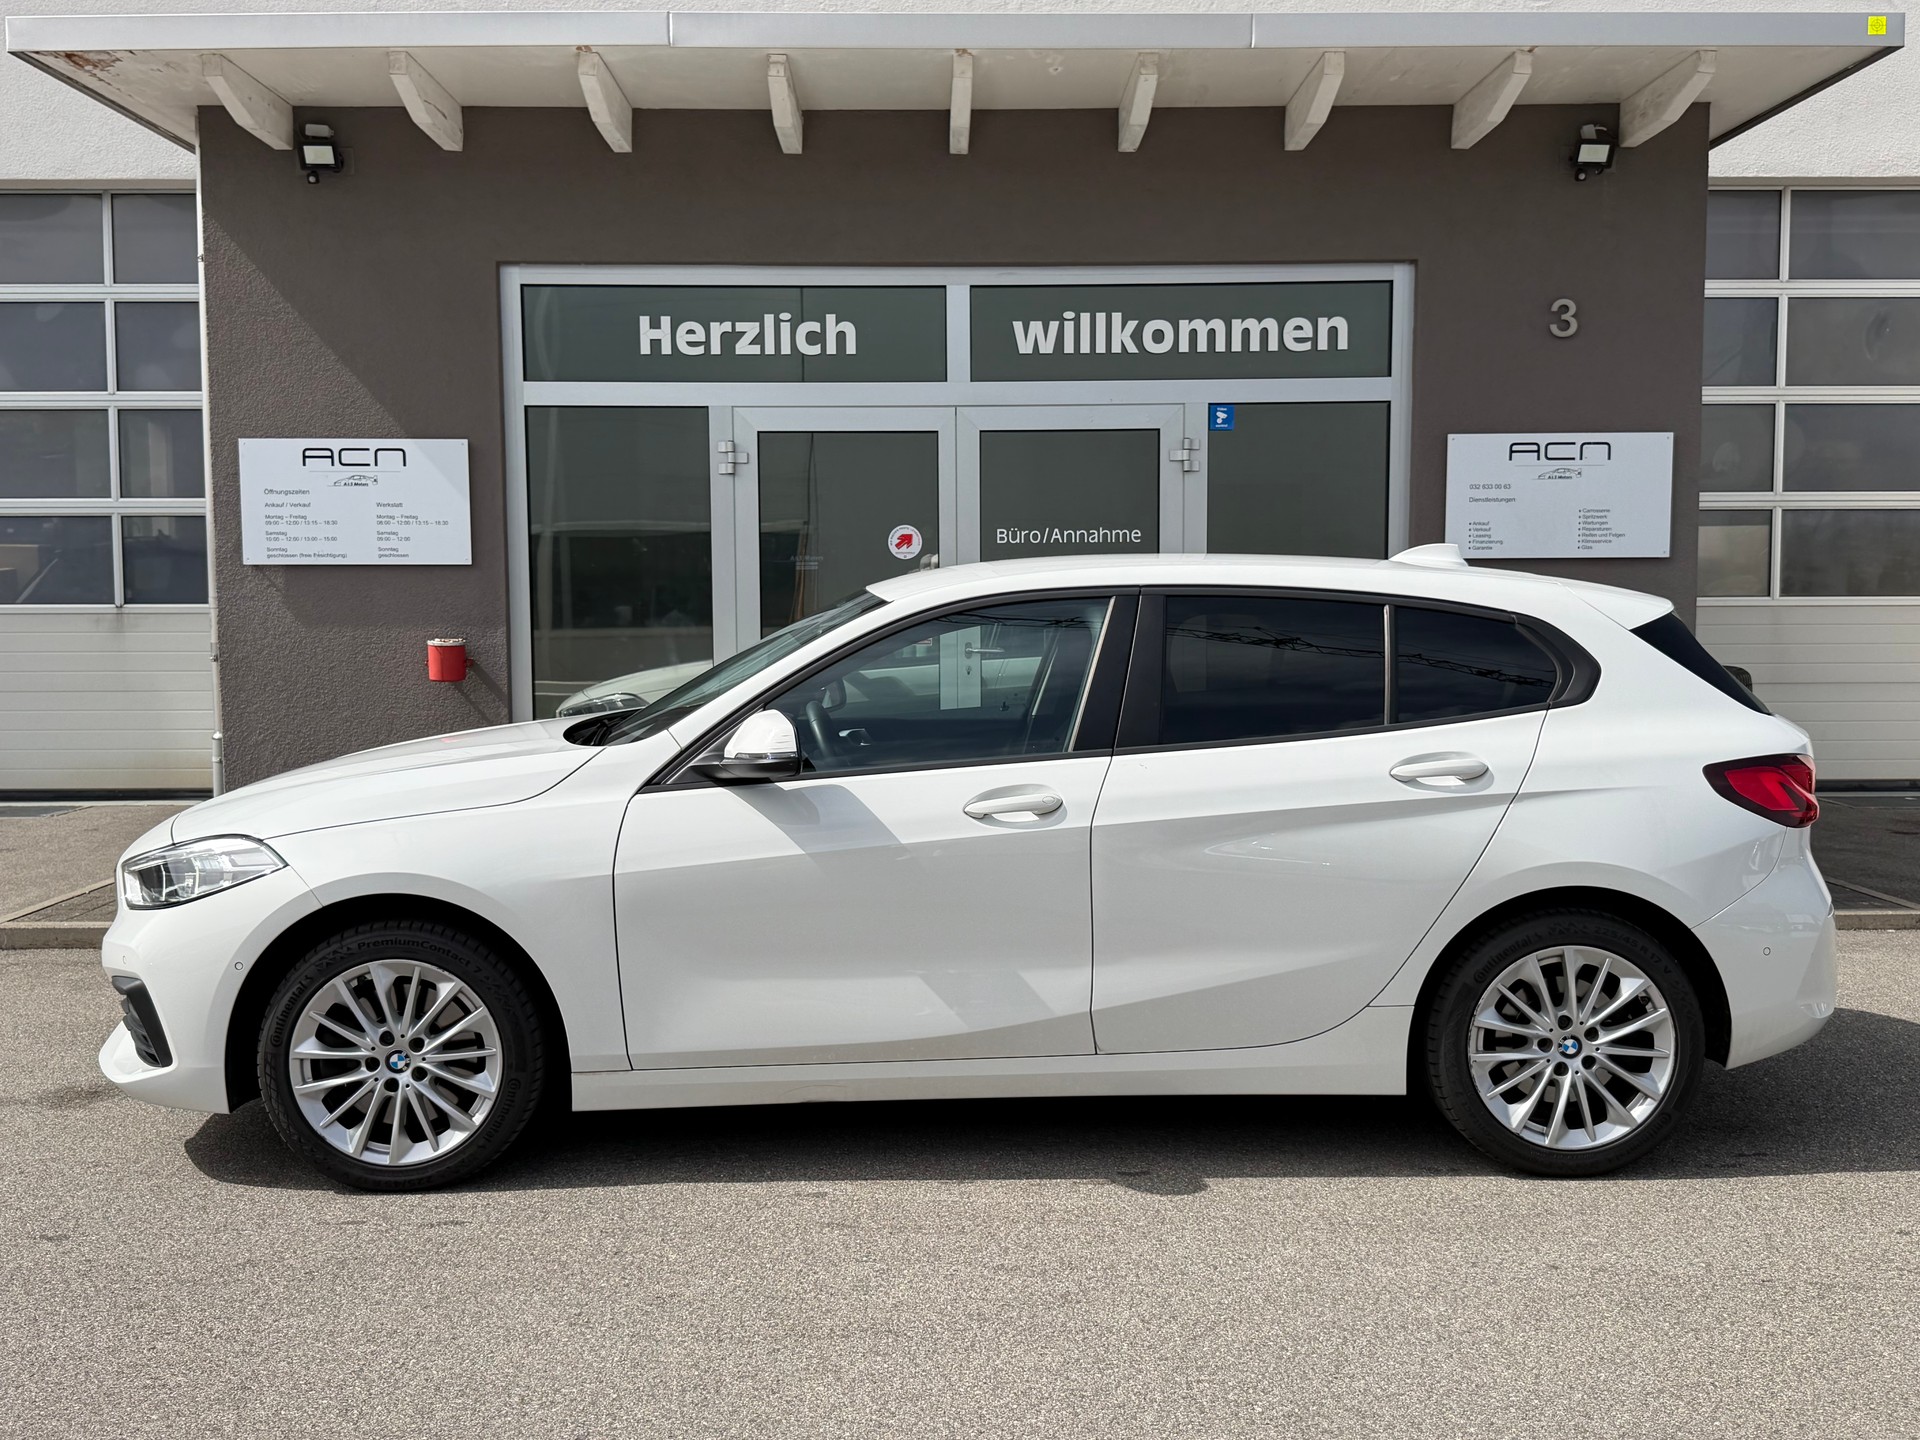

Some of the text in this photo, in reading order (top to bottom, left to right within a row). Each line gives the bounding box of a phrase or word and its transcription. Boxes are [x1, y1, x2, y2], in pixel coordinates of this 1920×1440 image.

[640, 313, 856, 355] Herzlich
[1013, 311, 1348, 353] willkommen
[1549, 305, 1575, 339] 3
[302, 448, 406, 467] ACN
[1509, 442, 1611, 461] ACN
[997, 527, 1141, 543] Büro/Annahme
[358, 936, 482, 974] PremiumContact 7
[1474, 934, 1532, 984] Continental
[270, 980, 308, 1047] Continental
[483, 1078, 521, 1142] Continental
